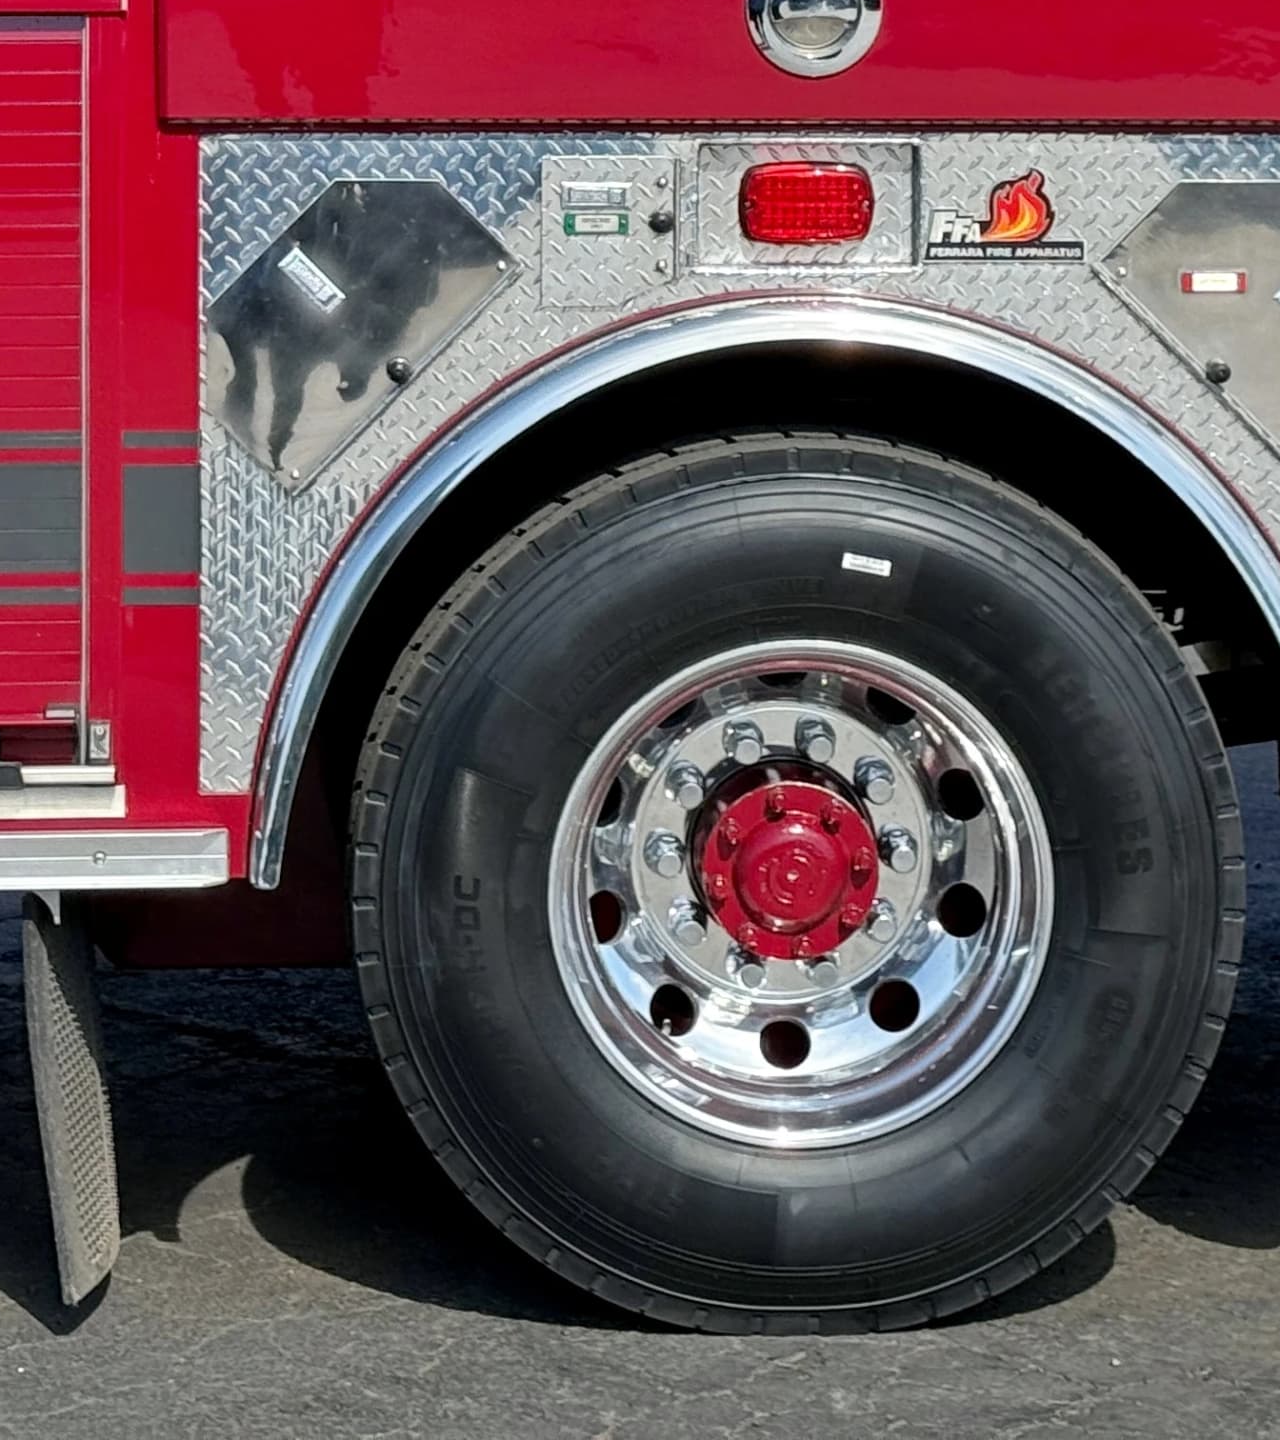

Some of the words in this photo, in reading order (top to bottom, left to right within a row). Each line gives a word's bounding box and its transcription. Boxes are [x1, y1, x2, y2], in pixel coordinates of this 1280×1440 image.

[929, 211, 982, 243] FFA
[929, 247, 984, 257] FERRARA
[986, 247, 1013, 257] FIRE
[1015, 247, 1082, 257] APPARATUS
